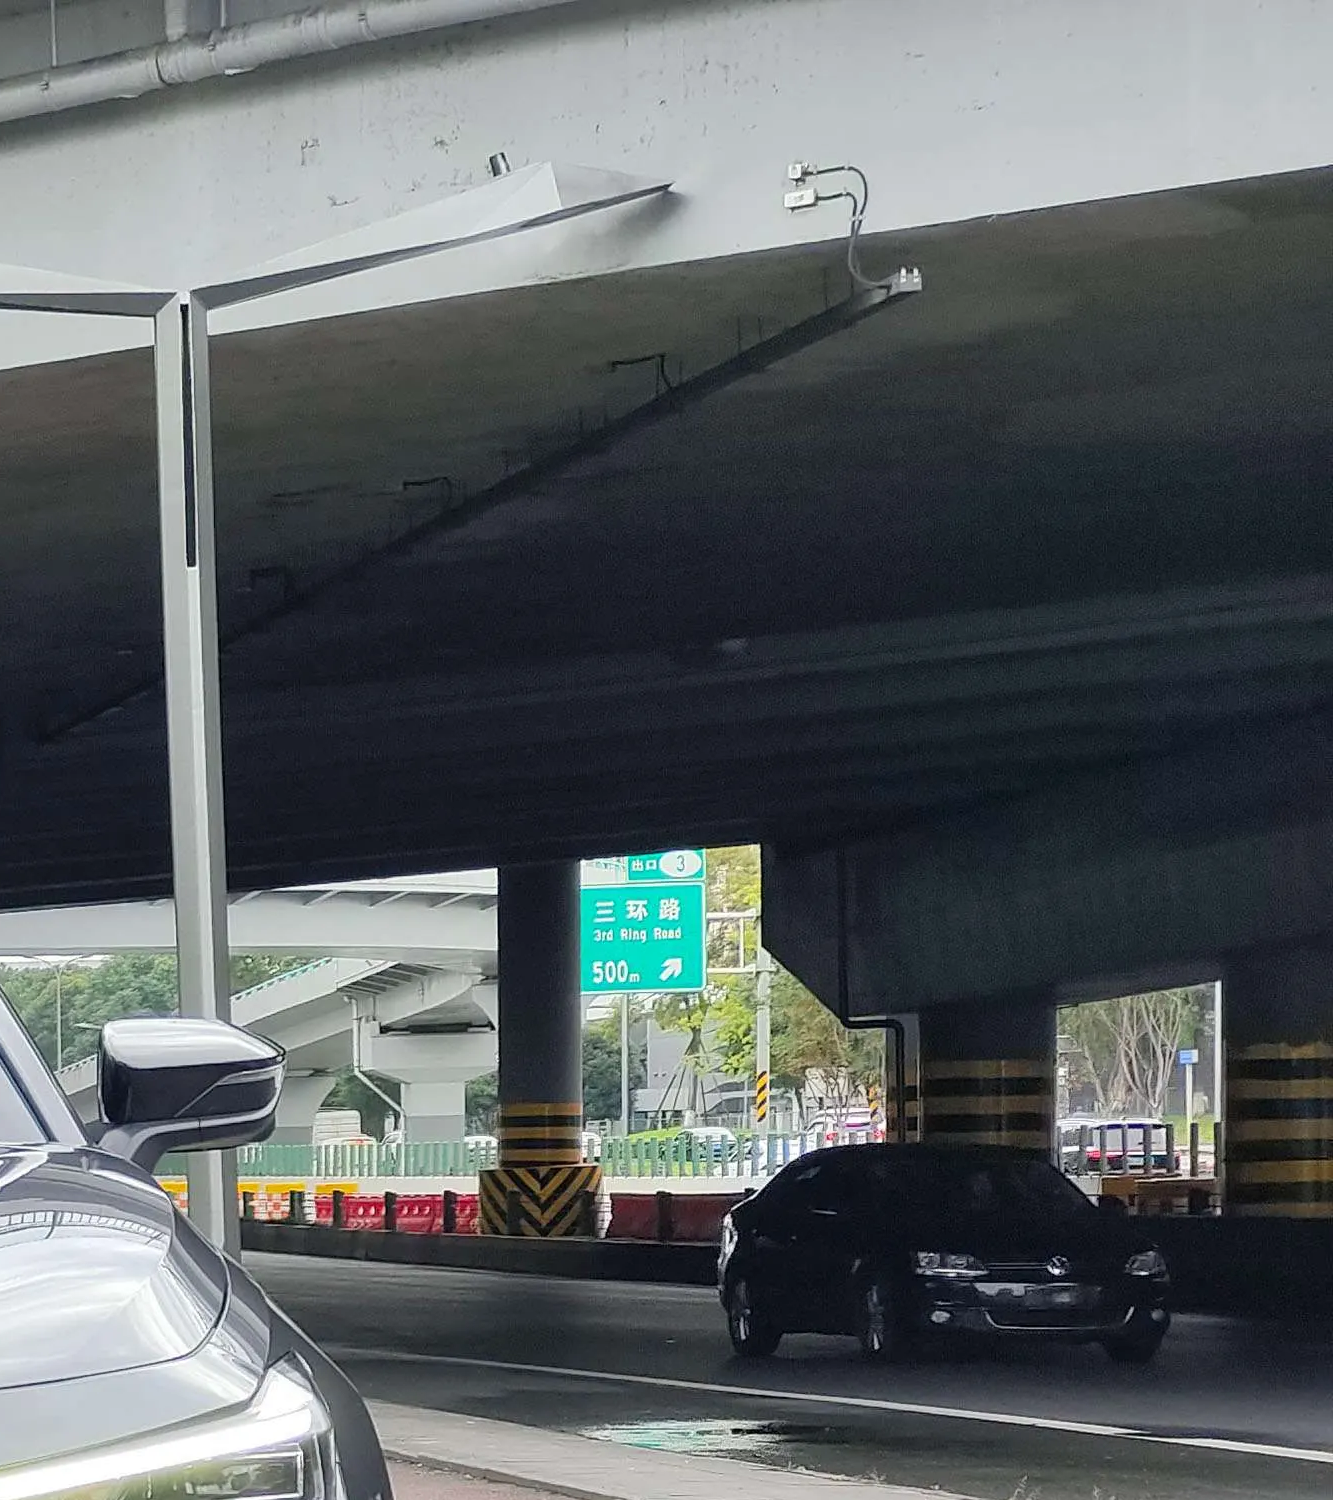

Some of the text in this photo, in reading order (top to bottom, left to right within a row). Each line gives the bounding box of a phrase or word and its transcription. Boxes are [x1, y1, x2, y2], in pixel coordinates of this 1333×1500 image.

[632, 855, 686, 872] 出口 3
[593, 898, 680, 923] 三环路
[593, 926, 682, 943] 3rd Ring Road
[592, 959, 641, 983] 500m
